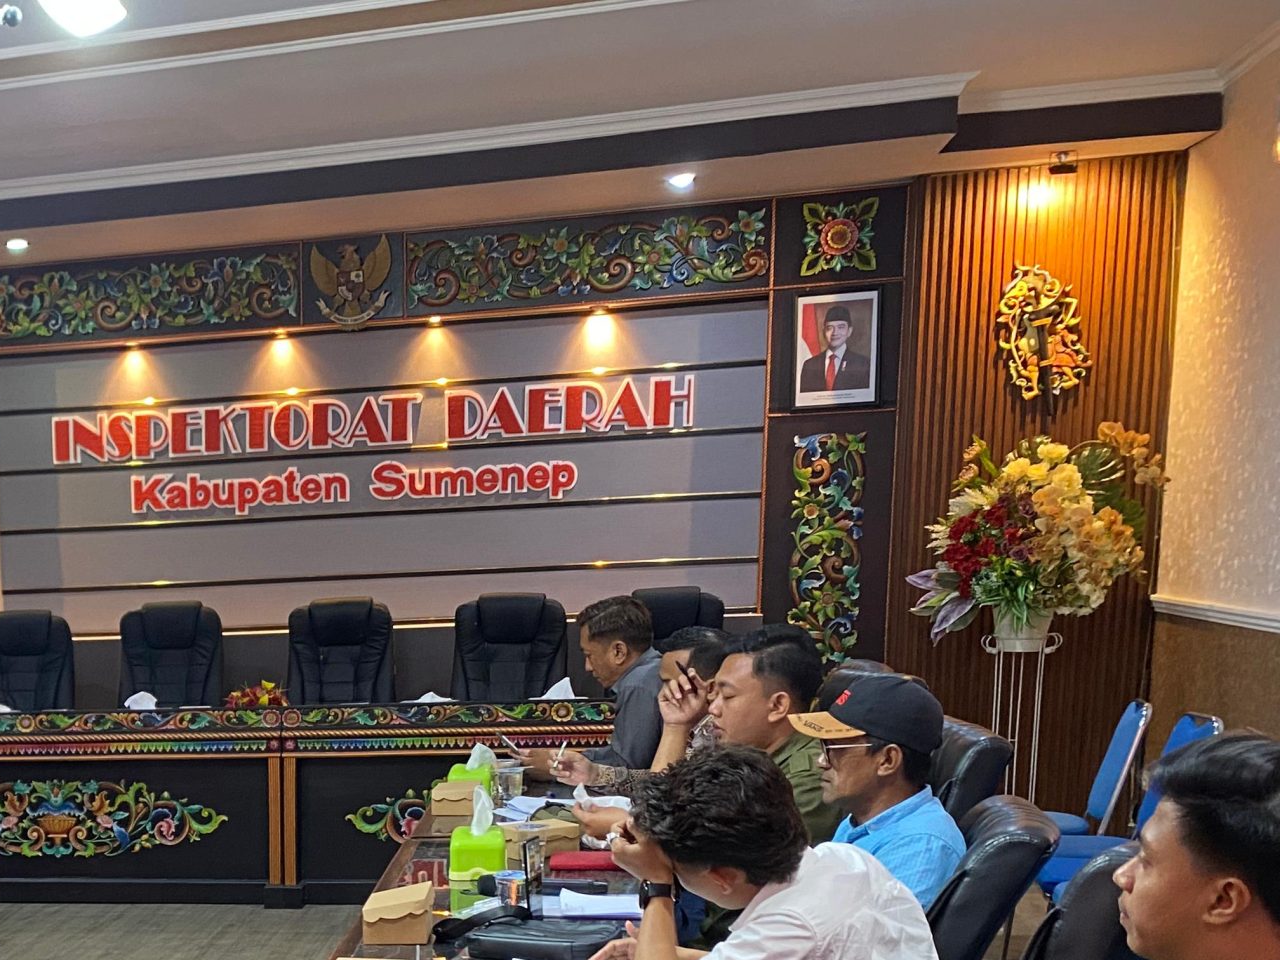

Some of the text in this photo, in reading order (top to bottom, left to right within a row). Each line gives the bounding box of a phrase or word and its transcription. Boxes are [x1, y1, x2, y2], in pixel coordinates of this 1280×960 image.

[52, 374, 695, 464] INSPEKTORAT DAERAH
[130, 460, 578, 515] Kabupaten Sumenep
